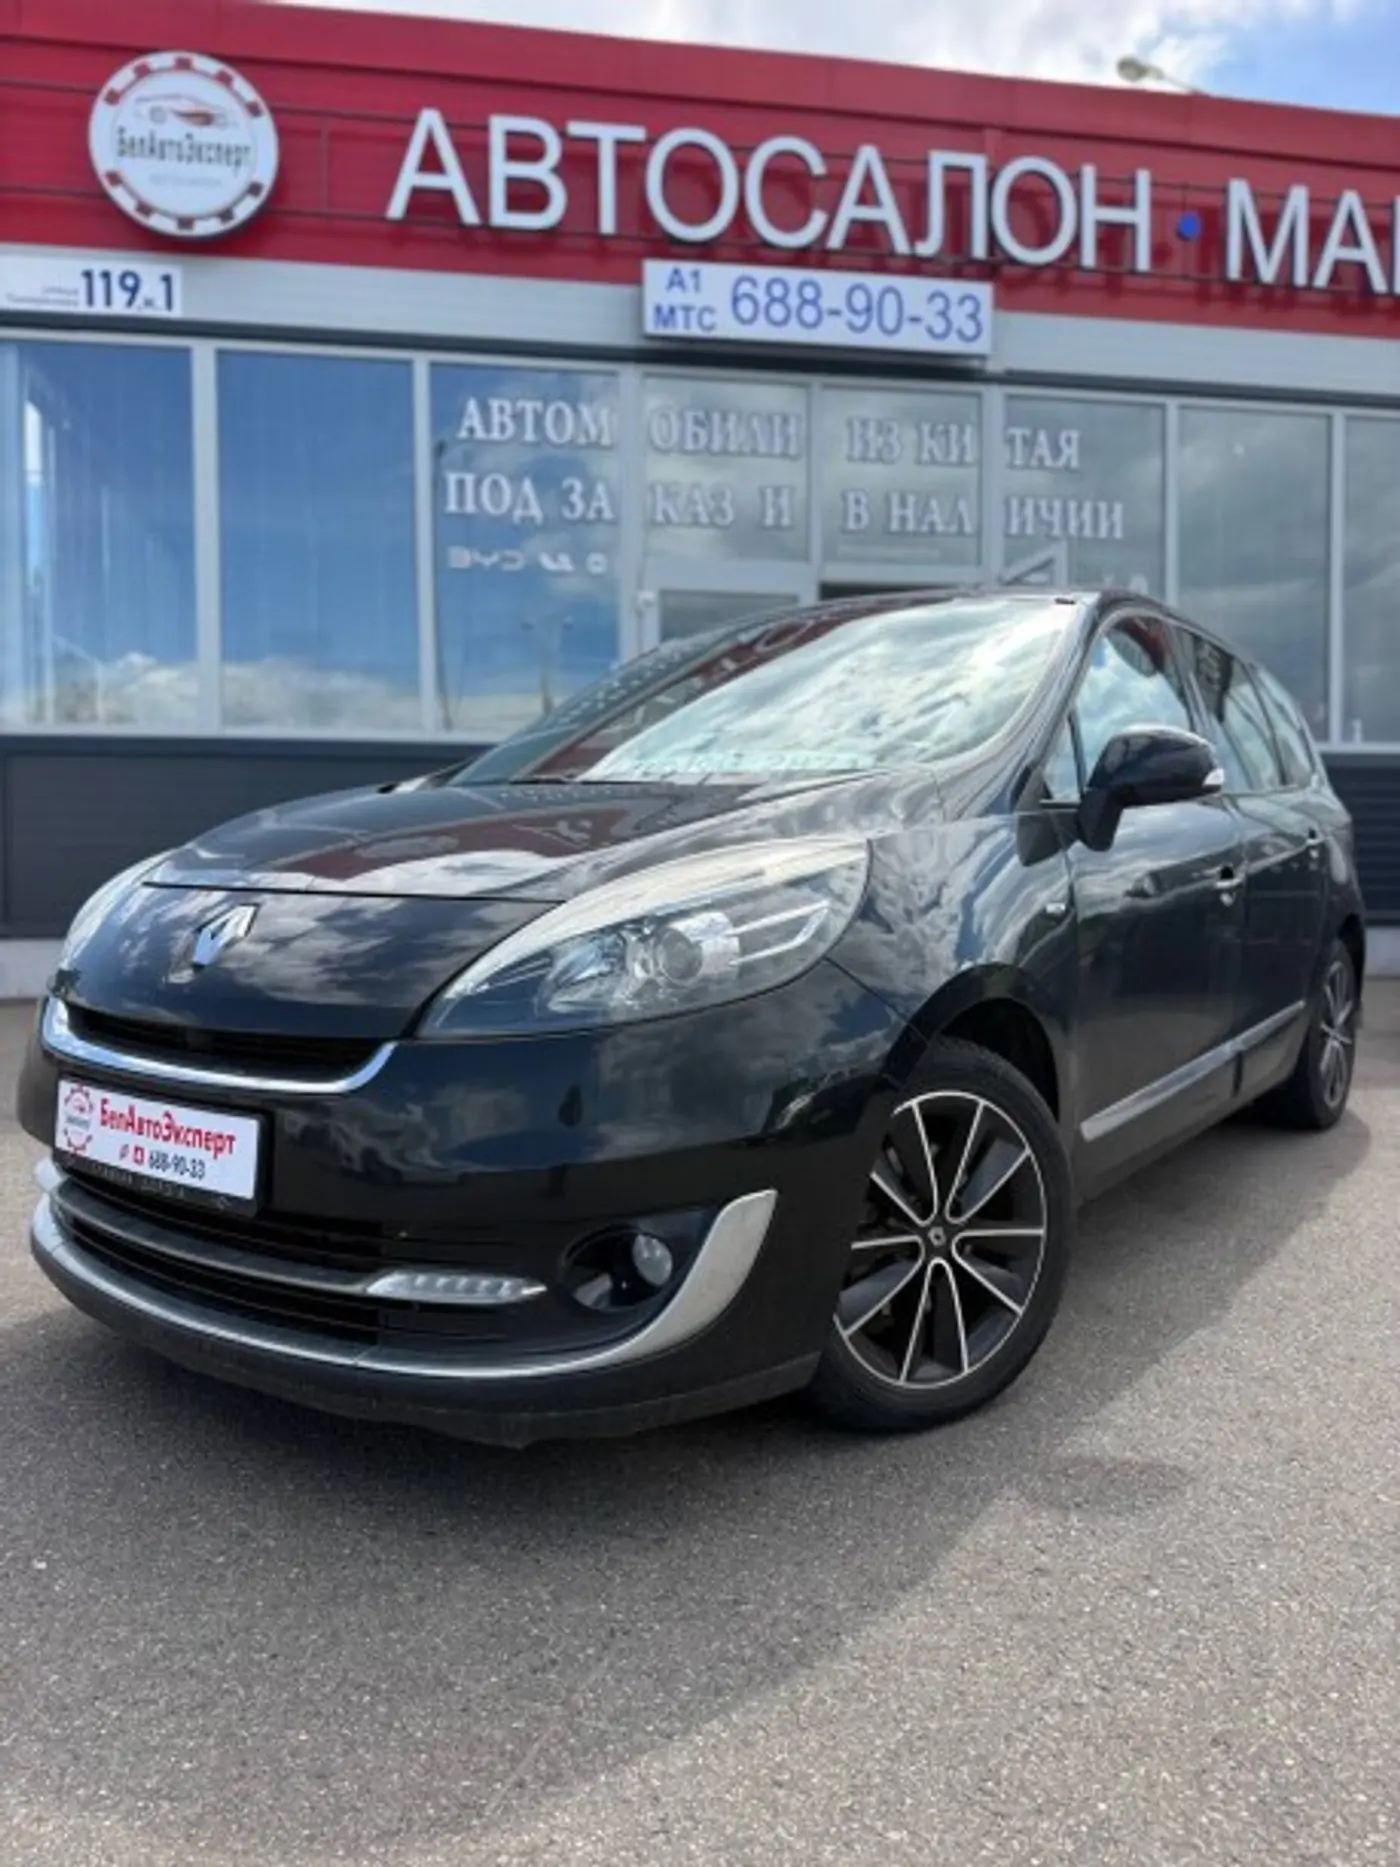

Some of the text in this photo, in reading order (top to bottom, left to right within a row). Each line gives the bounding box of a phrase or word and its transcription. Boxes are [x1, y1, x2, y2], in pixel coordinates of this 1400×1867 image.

[386, 107, 1400, 295] АВТОСАЛОН МА
[653, 304, 717, 332] МТС
[731, 275, 984, 344] 688-90-33
[846, 417, 901, 462] ИЗ
[445, 471, 544, 526] ПОД
[762, 487, 792, 526] И
[843, 490, 870, 531] В
[100, 1098, 236, 1160] БелАвтоЭксперт
